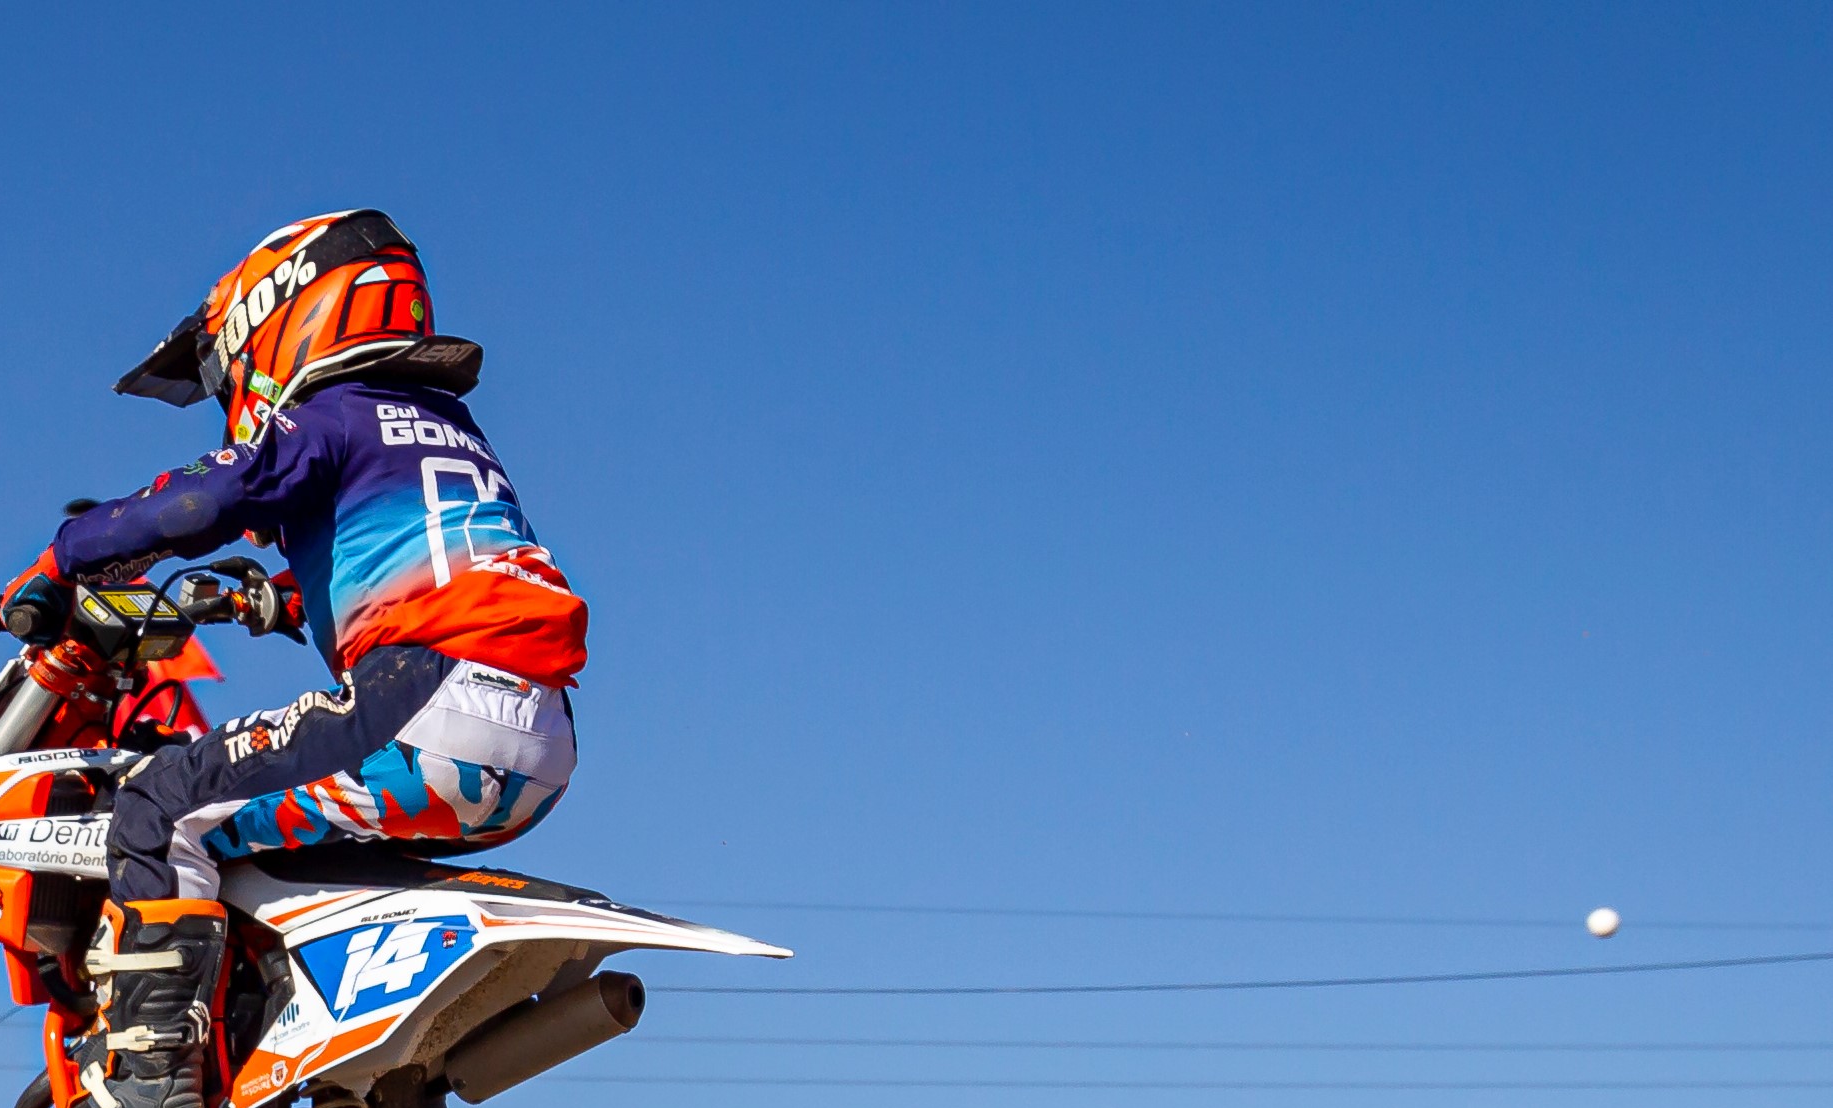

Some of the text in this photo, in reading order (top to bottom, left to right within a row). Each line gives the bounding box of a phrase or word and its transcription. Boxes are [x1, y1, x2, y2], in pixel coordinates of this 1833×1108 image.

[29, 819, 105, 848] Dent
[71, 852, 106, 867] Dent
[334, 921, 443, 1012] 14
